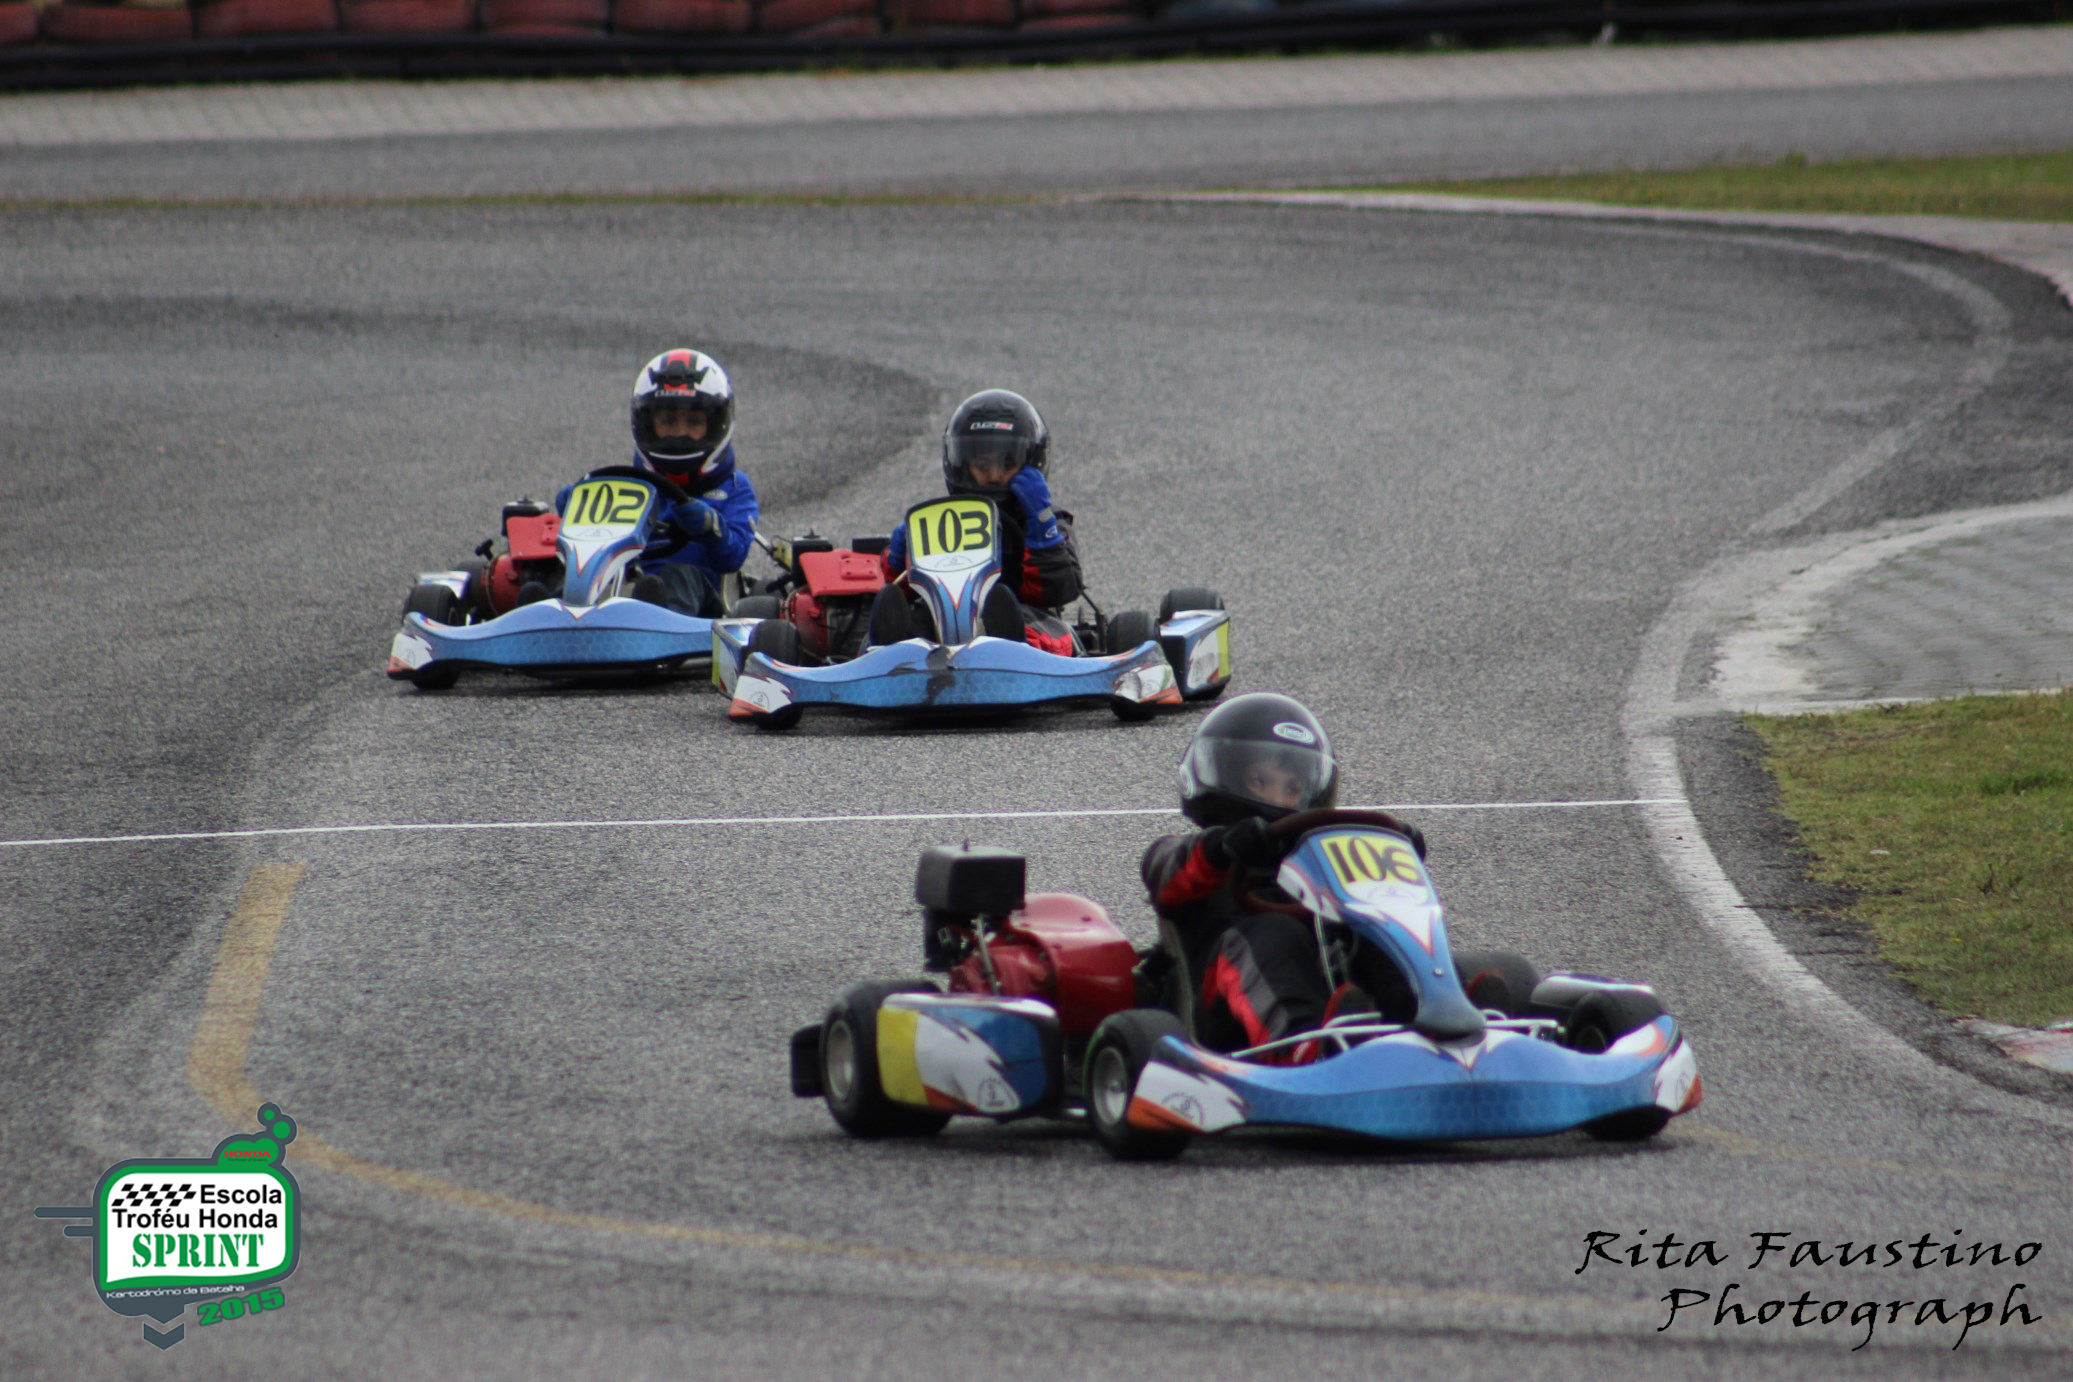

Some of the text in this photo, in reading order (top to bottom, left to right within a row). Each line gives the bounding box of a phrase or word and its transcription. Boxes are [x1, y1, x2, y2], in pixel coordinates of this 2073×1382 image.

[573, 483, 646, 524] 102
[919, 508, 991, 555] 103
[1328, 837, 1426, 886] 106
